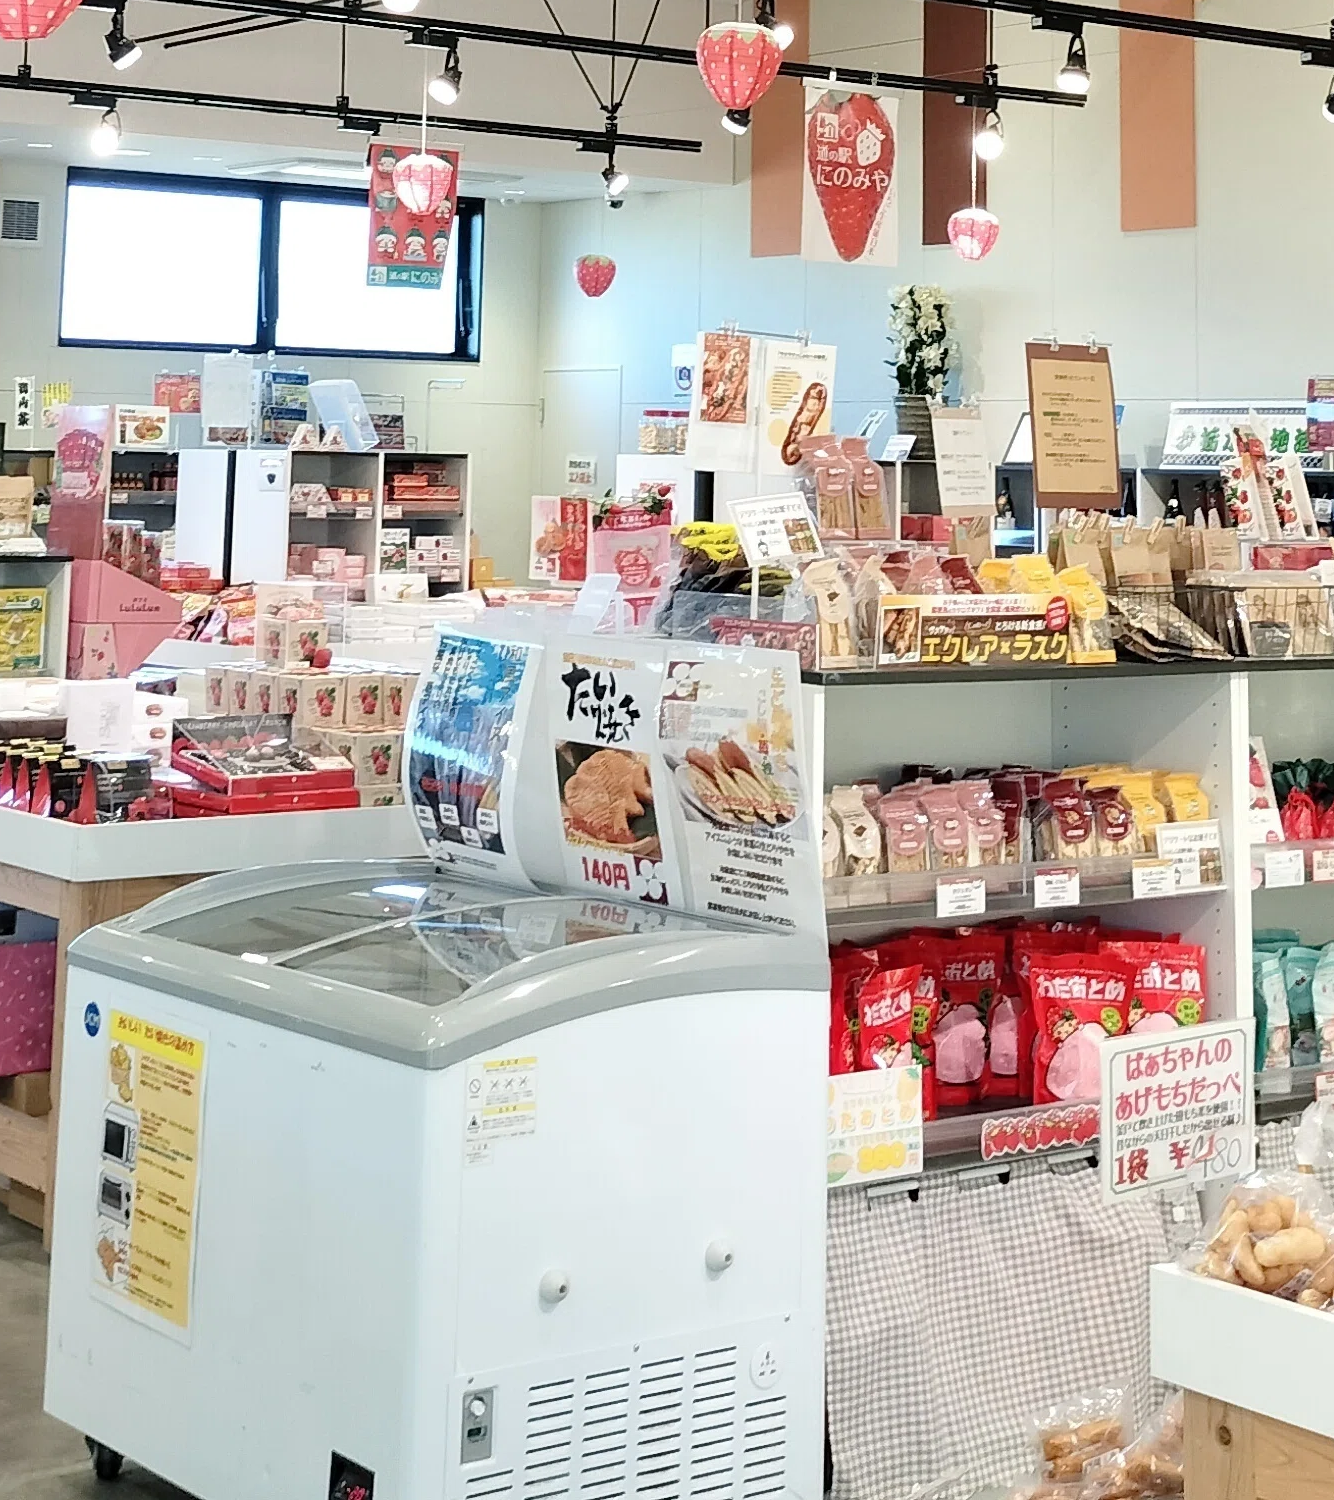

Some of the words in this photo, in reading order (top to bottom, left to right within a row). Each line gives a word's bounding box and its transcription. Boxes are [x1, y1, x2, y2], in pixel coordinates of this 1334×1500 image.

[816, 145, 853, 164] 道の駅
[816, 164, 890, 192] にのみや
[581, 855, 631, 891] 140円
[1035, 973, 1127, 1002] わたおとめ
[1115, 1148, 1150, 1186] 1袋
